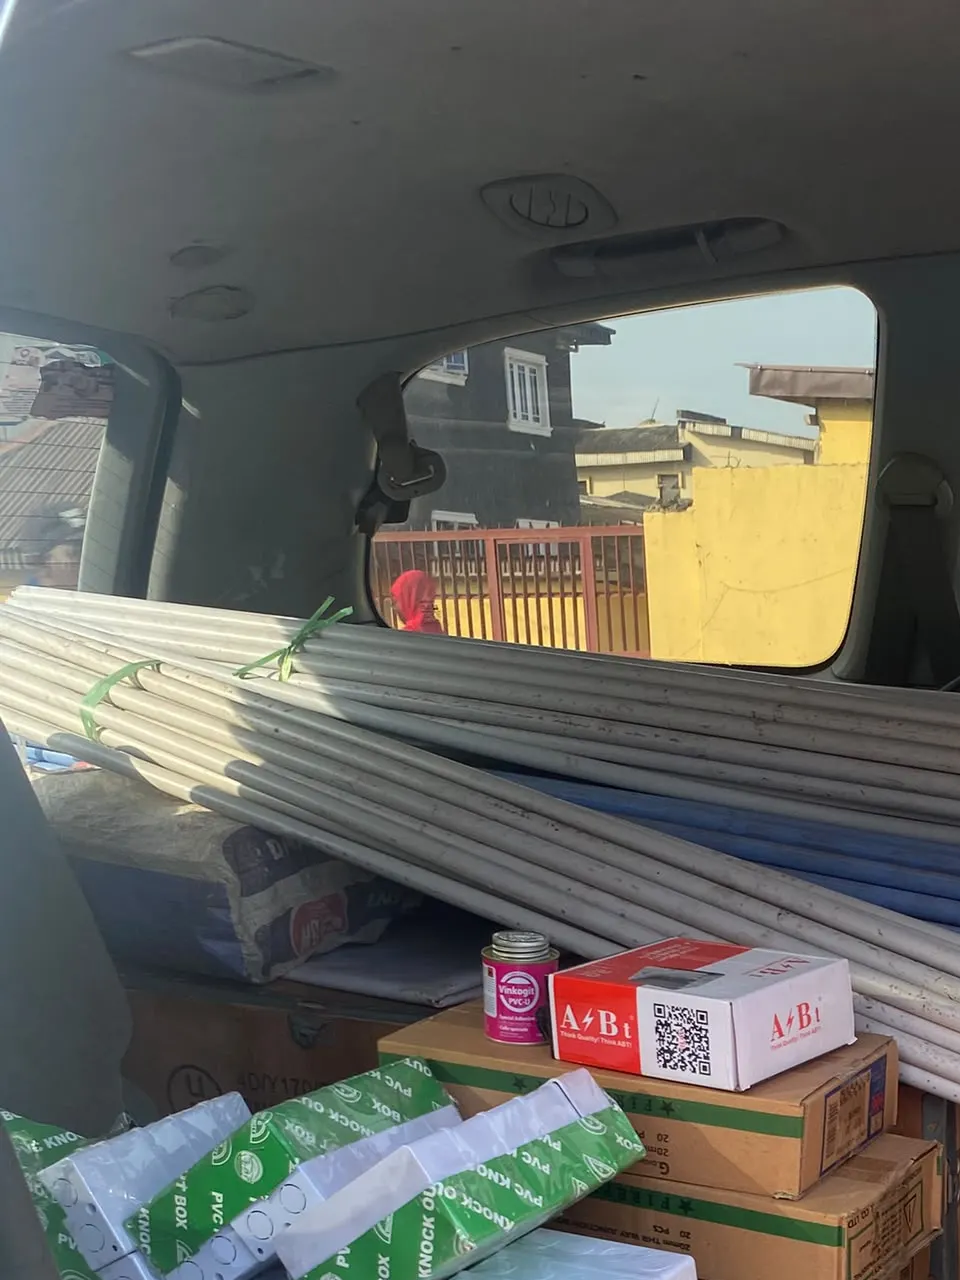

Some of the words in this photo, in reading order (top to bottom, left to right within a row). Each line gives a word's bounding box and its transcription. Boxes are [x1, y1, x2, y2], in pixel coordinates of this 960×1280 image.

[385, 1075, 413, 1098] PVC
[329, 1108, 375, 1137] NOCK
[371, 1097, 400, 1122] BOX
[521, 1151, 551, 1176] PVC
[476, 1164, 512, 1190] KNO
[211, 1191, 224, 1225] PVC
[514, 1183, 544, 1208] PVC
[175, 1194, 188, 1230] BOX
[460, 1192, 516, 1233] KNOCK
[653, 1225, 670, 1234] PCS
[418, 1216, 435, 1278] KNOCK
